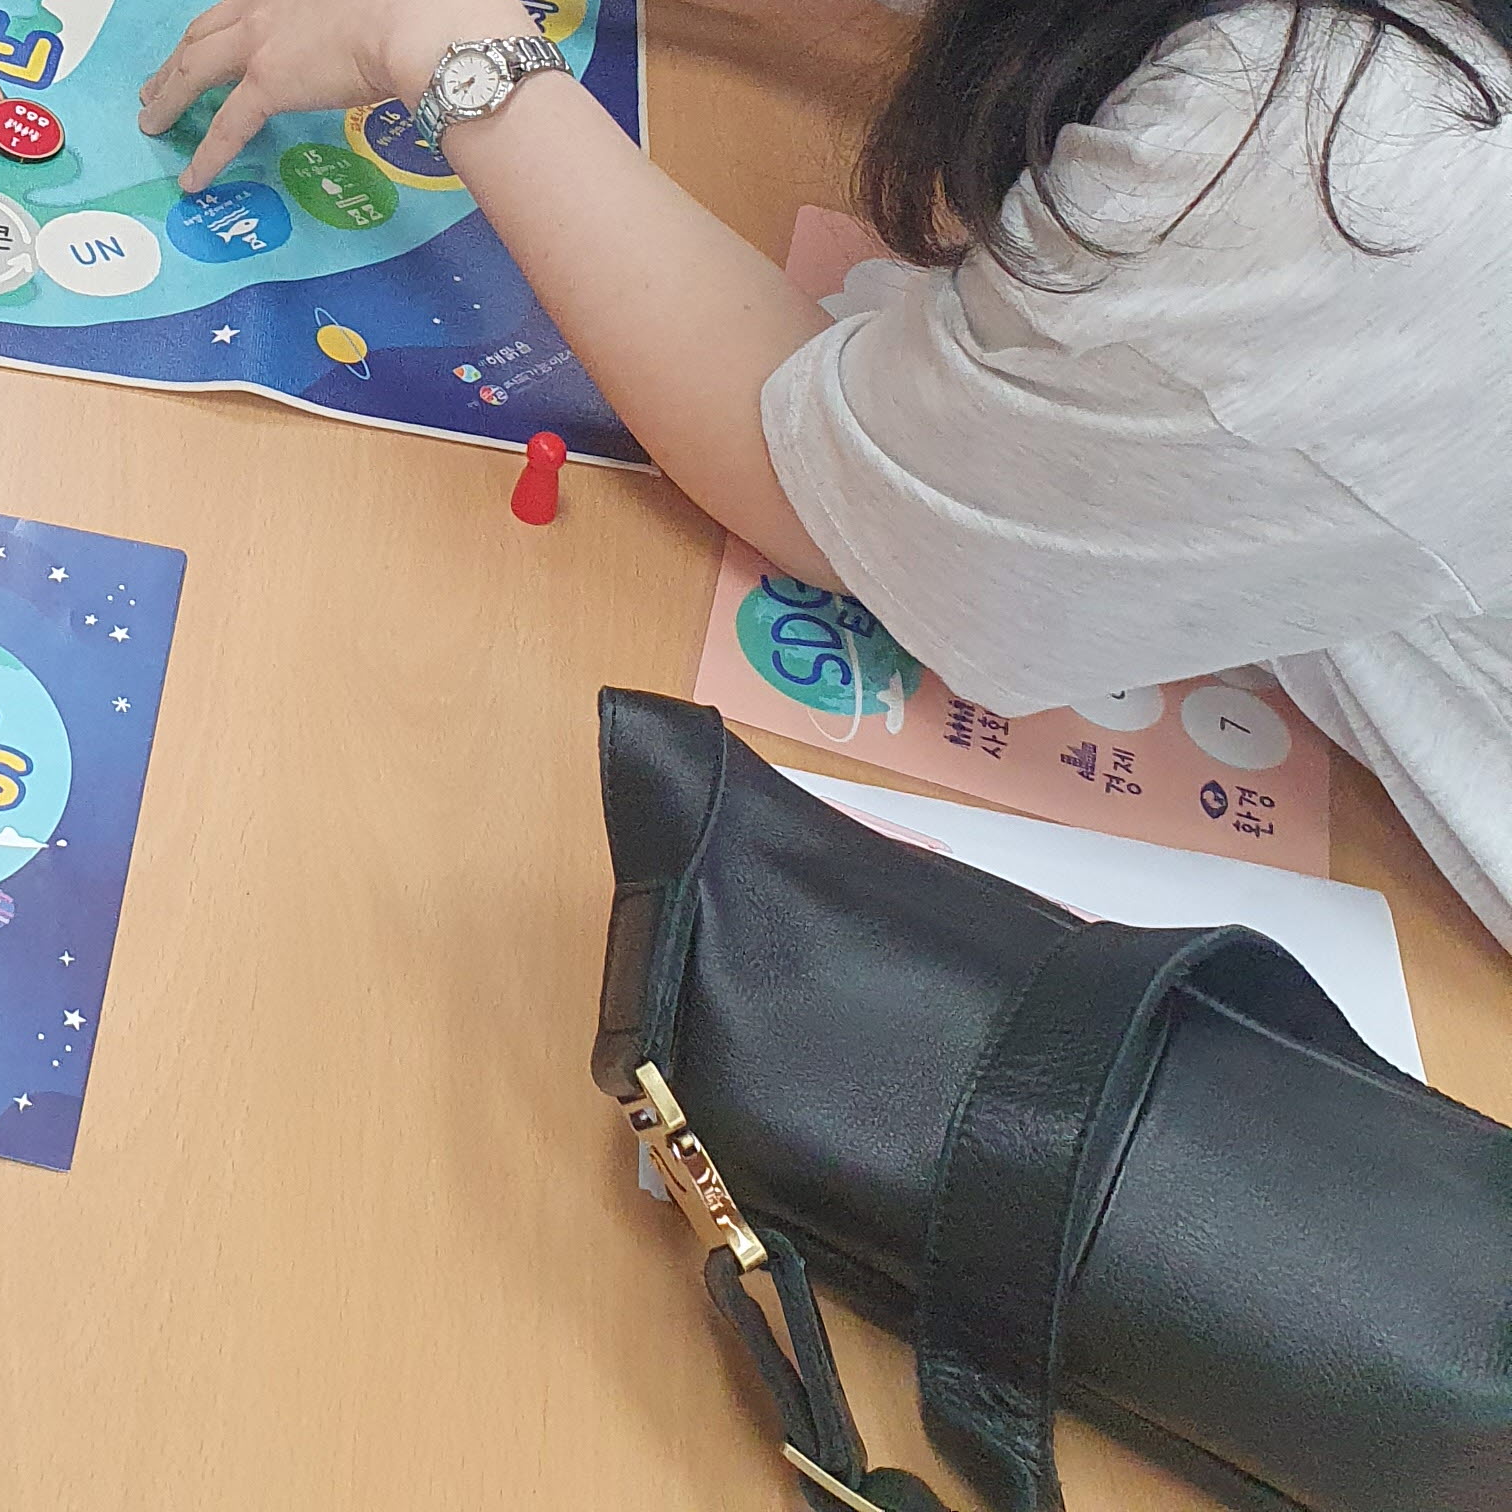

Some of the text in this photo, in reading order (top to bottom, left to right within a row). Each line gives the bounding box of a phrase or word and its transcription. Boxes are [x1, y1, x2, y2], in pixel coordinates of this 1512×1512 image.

[302, 149, 324, 165] 15
[195, 194, 219, 209] 14
[68, 234, 126, 266] UN
[1219, 716, 1252, 734] 7
[1102, 746, 1143, 795] 경제
[1232, 785, 1276, 838] 환경
